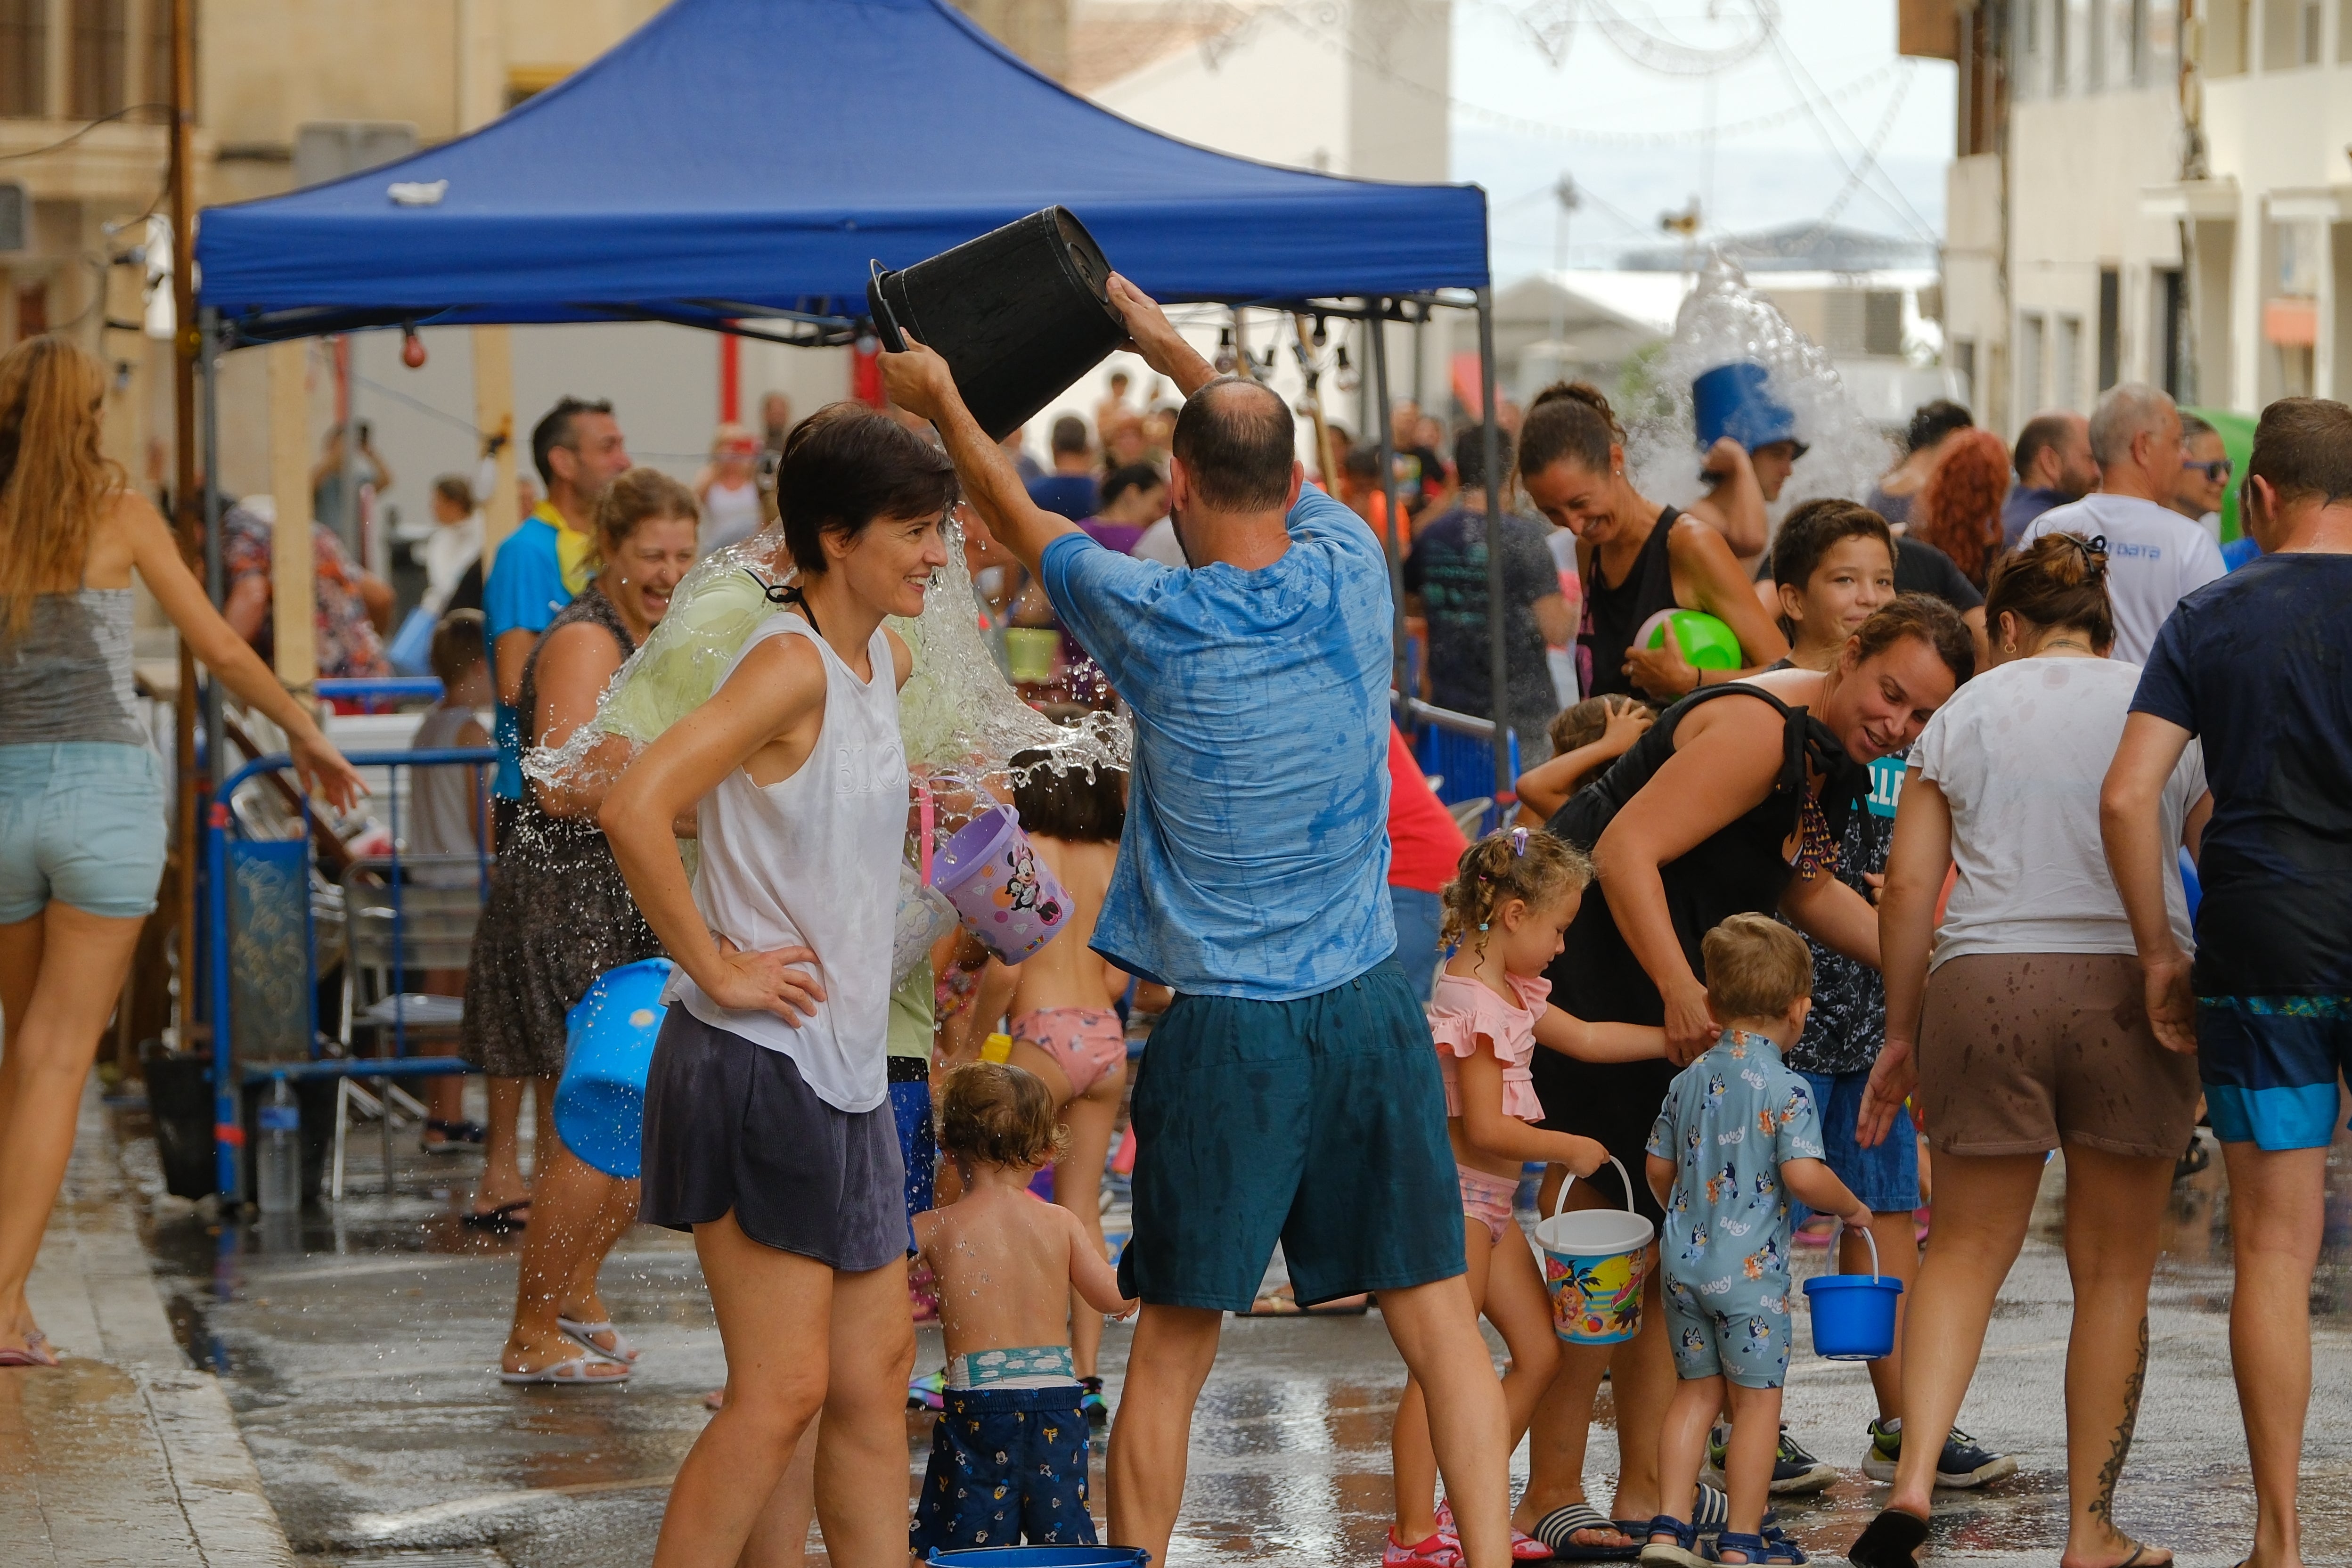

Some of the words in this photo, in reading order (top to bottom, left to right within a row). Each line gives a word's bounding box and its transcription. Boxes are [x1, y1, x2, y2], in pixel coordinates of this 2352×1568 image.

[1718, 1126, 1745, 1146] BLUEY
[1792, 1136, 1822, 1156] BLUEY
[1720, 1216, 1751, 1237] BLUEY
[1700, 1274, 1731, 1296] BLUEY
